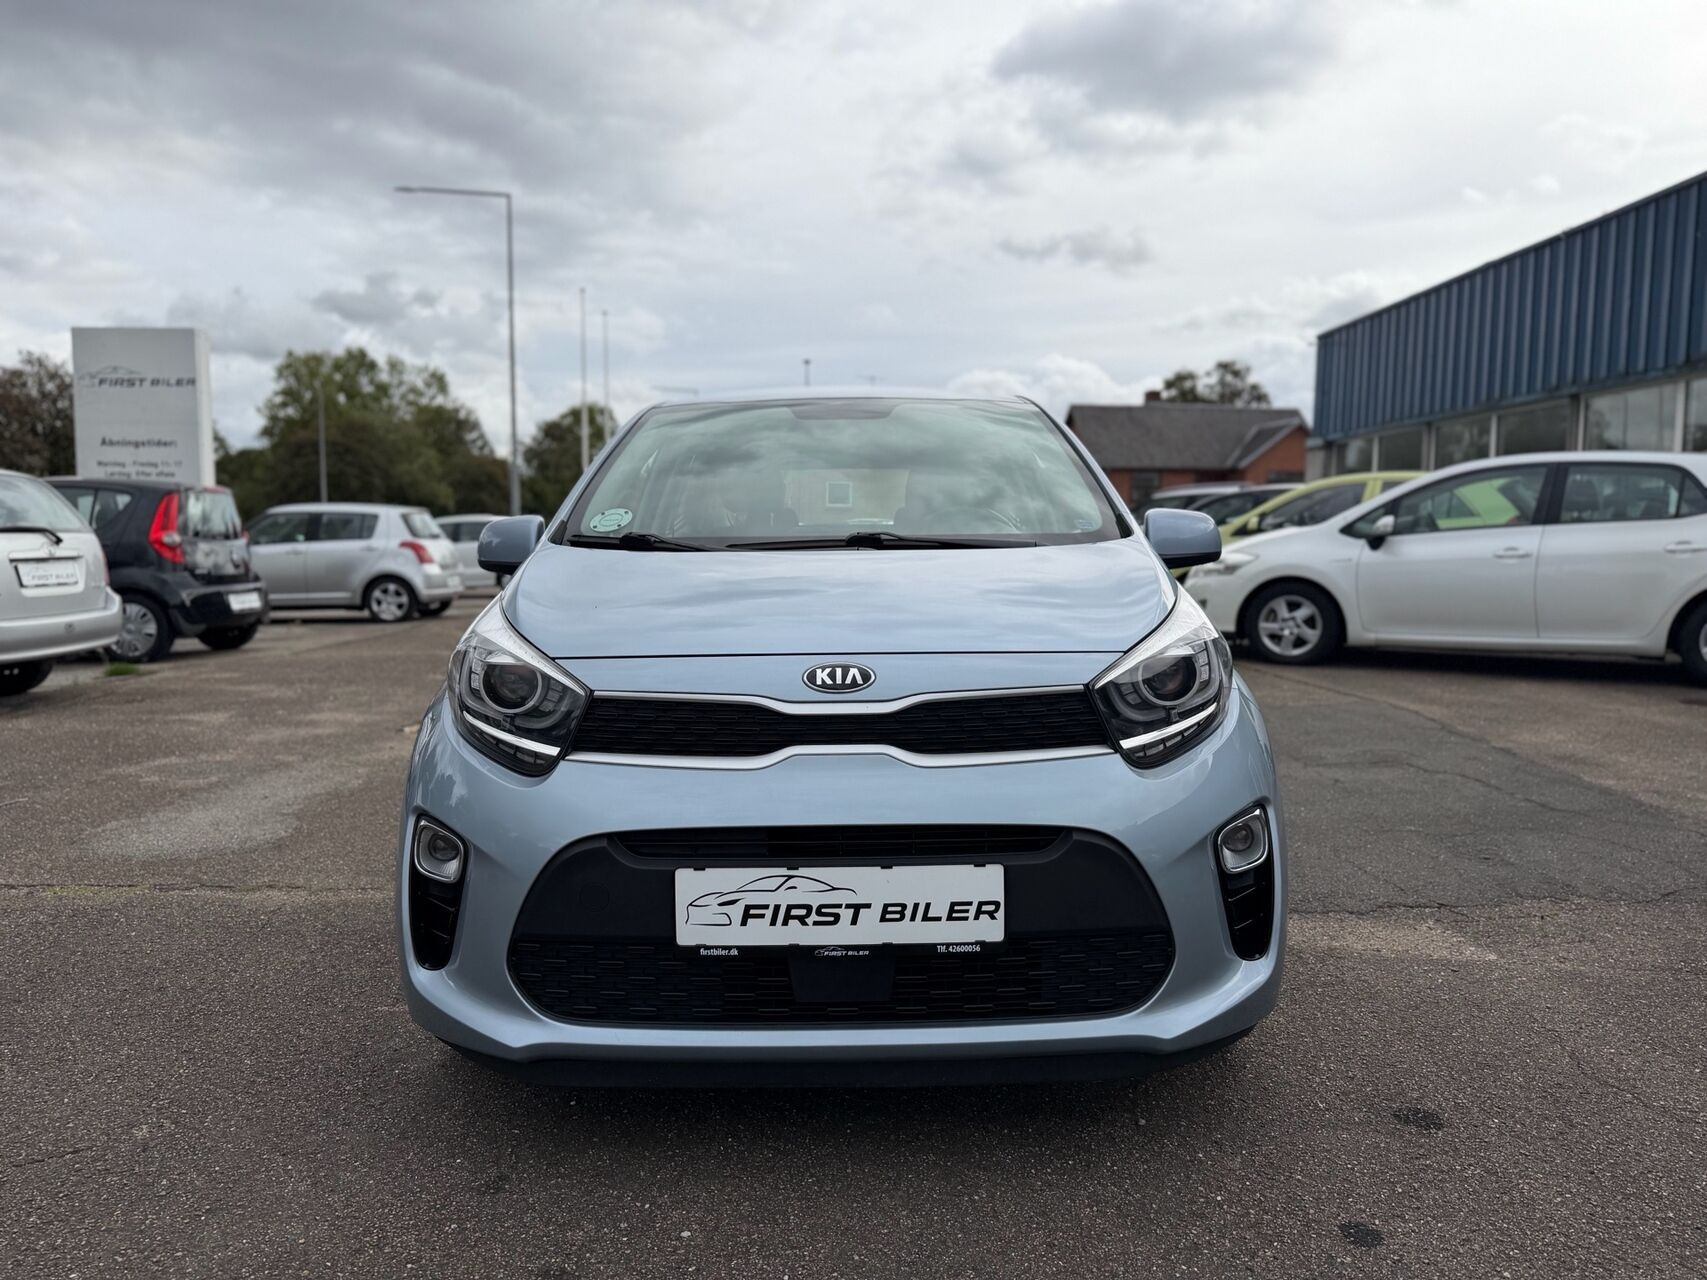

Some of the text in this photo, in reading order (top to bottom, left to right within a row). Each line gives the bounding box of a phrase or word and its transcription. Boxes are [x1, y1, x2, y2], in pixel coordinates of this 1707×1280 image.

[98, 377, 196, 387] FIRST BILER
[815, 667, 864, 685] KIA
[739, 900, 1002, 927] FIRST BILER
[700, 947, 739, 957] firstbiler.dk
[847, 949, 870, 957] BILER
[936, 944, 981, 953] Tlf. 42600056
